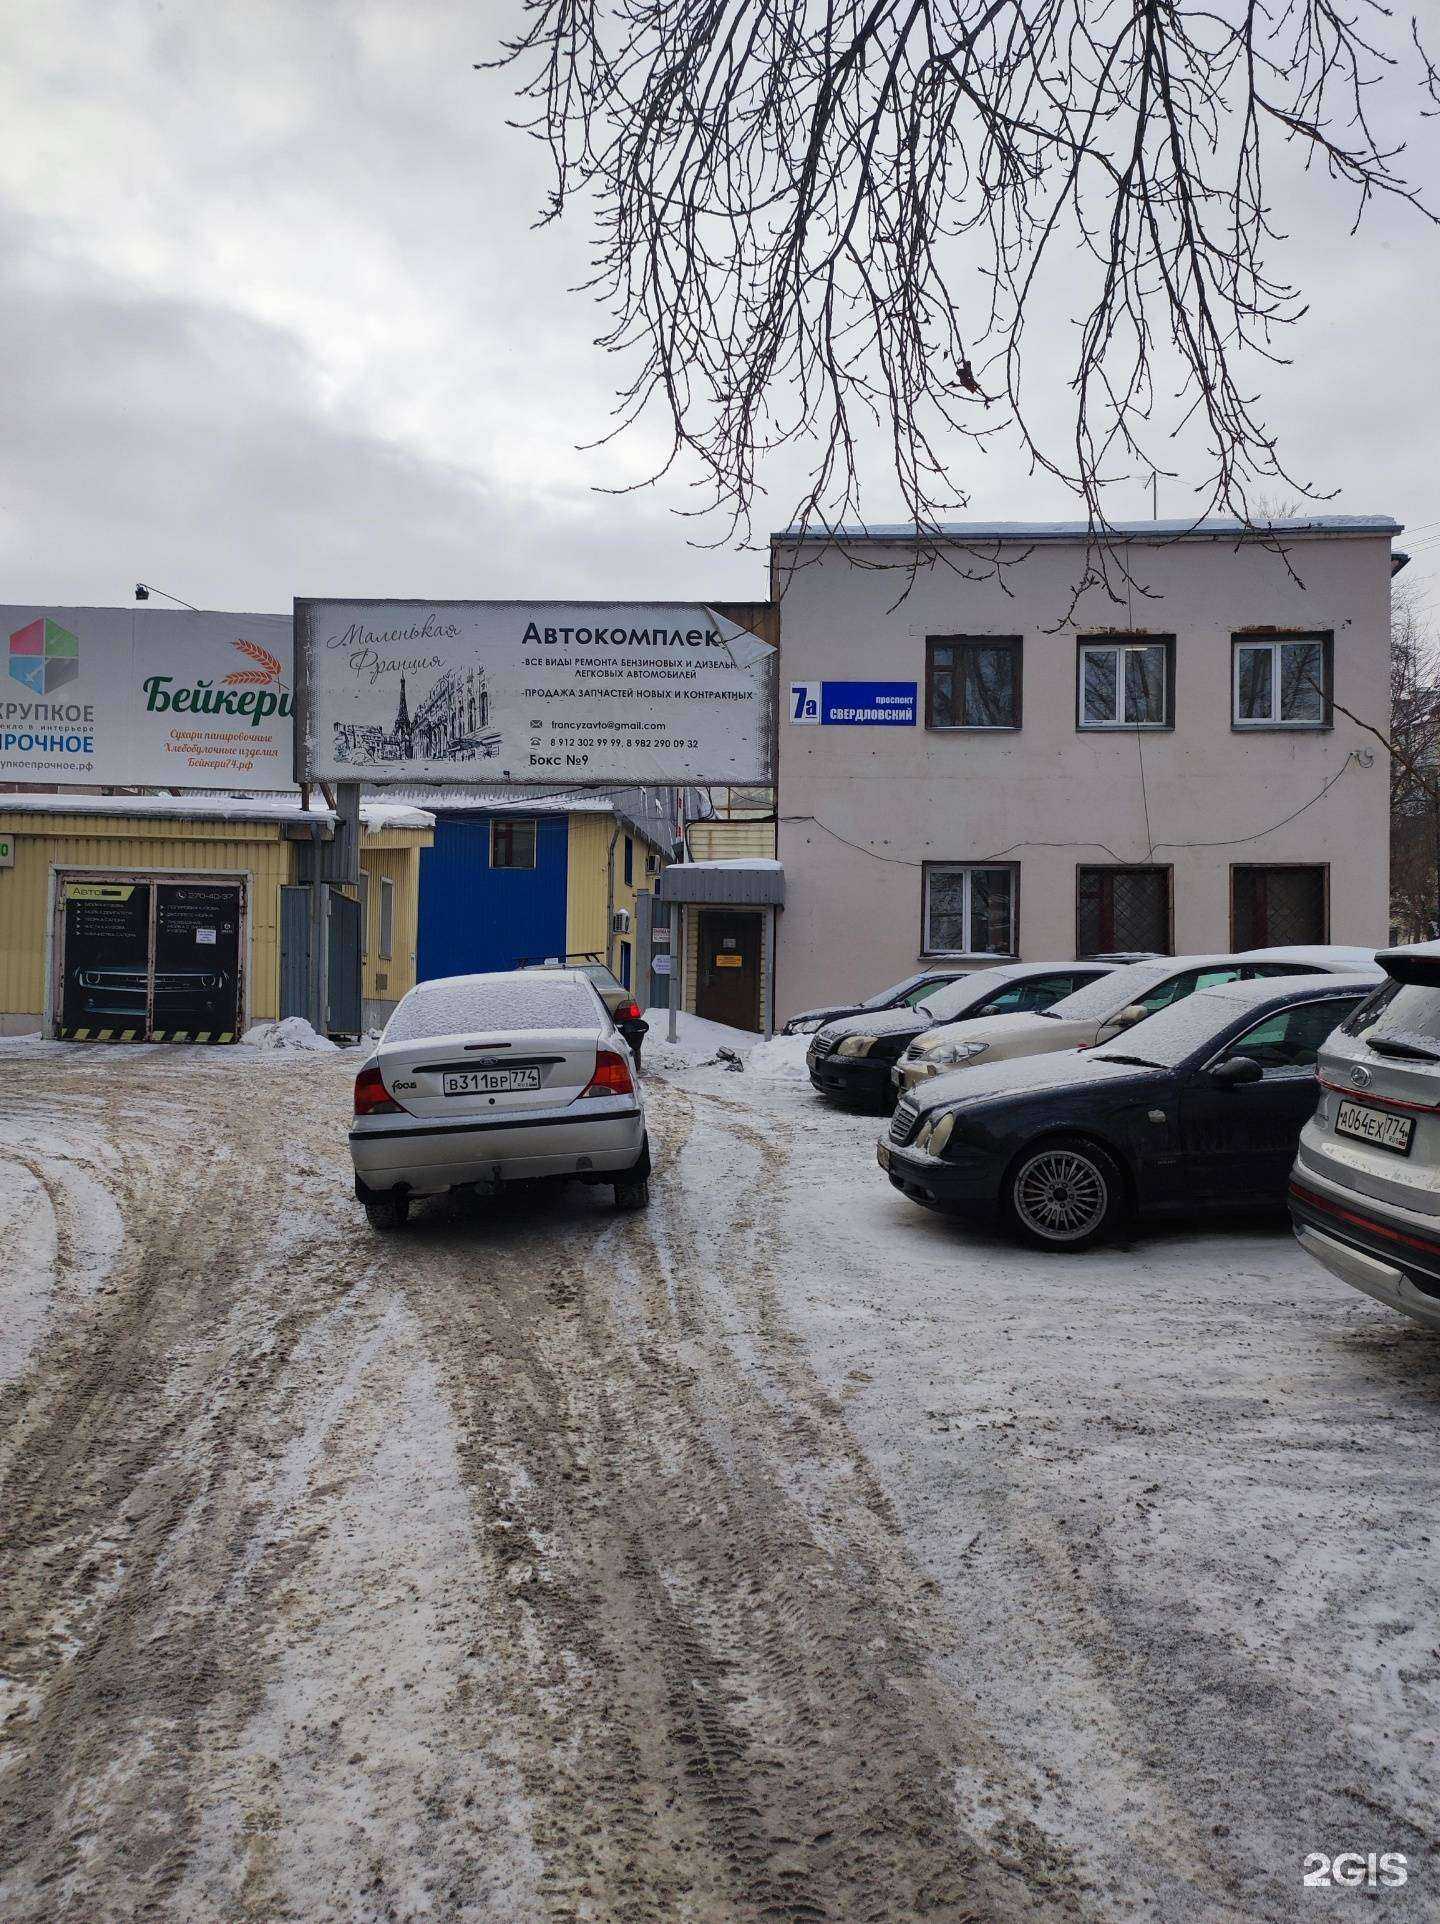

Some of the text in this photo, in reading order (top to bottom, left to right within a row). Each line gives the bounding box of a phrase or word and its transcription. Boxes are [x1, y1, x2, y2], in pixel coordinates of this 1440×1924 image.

[326, 613, 462, 650] Маленькая
[349, 648, 446, 685] Франция
[545, 658, 572, 667] ВИДЫ
[574, 658, 618, 667] РЕМОНТА
[621, 658, 683, 669] БЕНЗИНОВЫХ
[685, 659, 692, 668] И
[694, 659, 751, 671] ДИЗЕЛЬН
[574, 669, 697, 680] ЛЕГКОВЫХ АВТОМОБИЛЕЙ
[578, 687, 634, 699] ЗАПЧАСТЕЙ
[636, 689, 671, 699] НОВЫХ
[674, 690, 681, 699] И
[683, 690, 753, 700] КОНТРАКТНЫХ
[791, 687, 817, 719] 7а
[875, 696, 914, 705] проспект
[829, 707, 913, 722] СВЕРДЛОВСКИЙ
[40, 725, 94, 734] интерьере
[551, 720, 666, 731] francyzavto@gmail.com
[169, 727, 272, 743] Сухари панировочные
[550, 738, 556, 747] 8
[558, 738, 575, 747] 912
[577, 738, 594, 747] 302
[597, 738, 608, 747] 99
[626, 739, 632, 747] 8
[635, 739, 651, 748] 982
[654, 739, 671, 748] 290
[673, 739, 685, 748] 09
[687, 740, 699, 749] 32
[163, 741, 279, 760] Хлебобулочные изделия
[529, 754, 589, 766] Бокс №9
[511, 1071, 537, 1083] 774
[1386, 1117, 1407, 1139] 774
